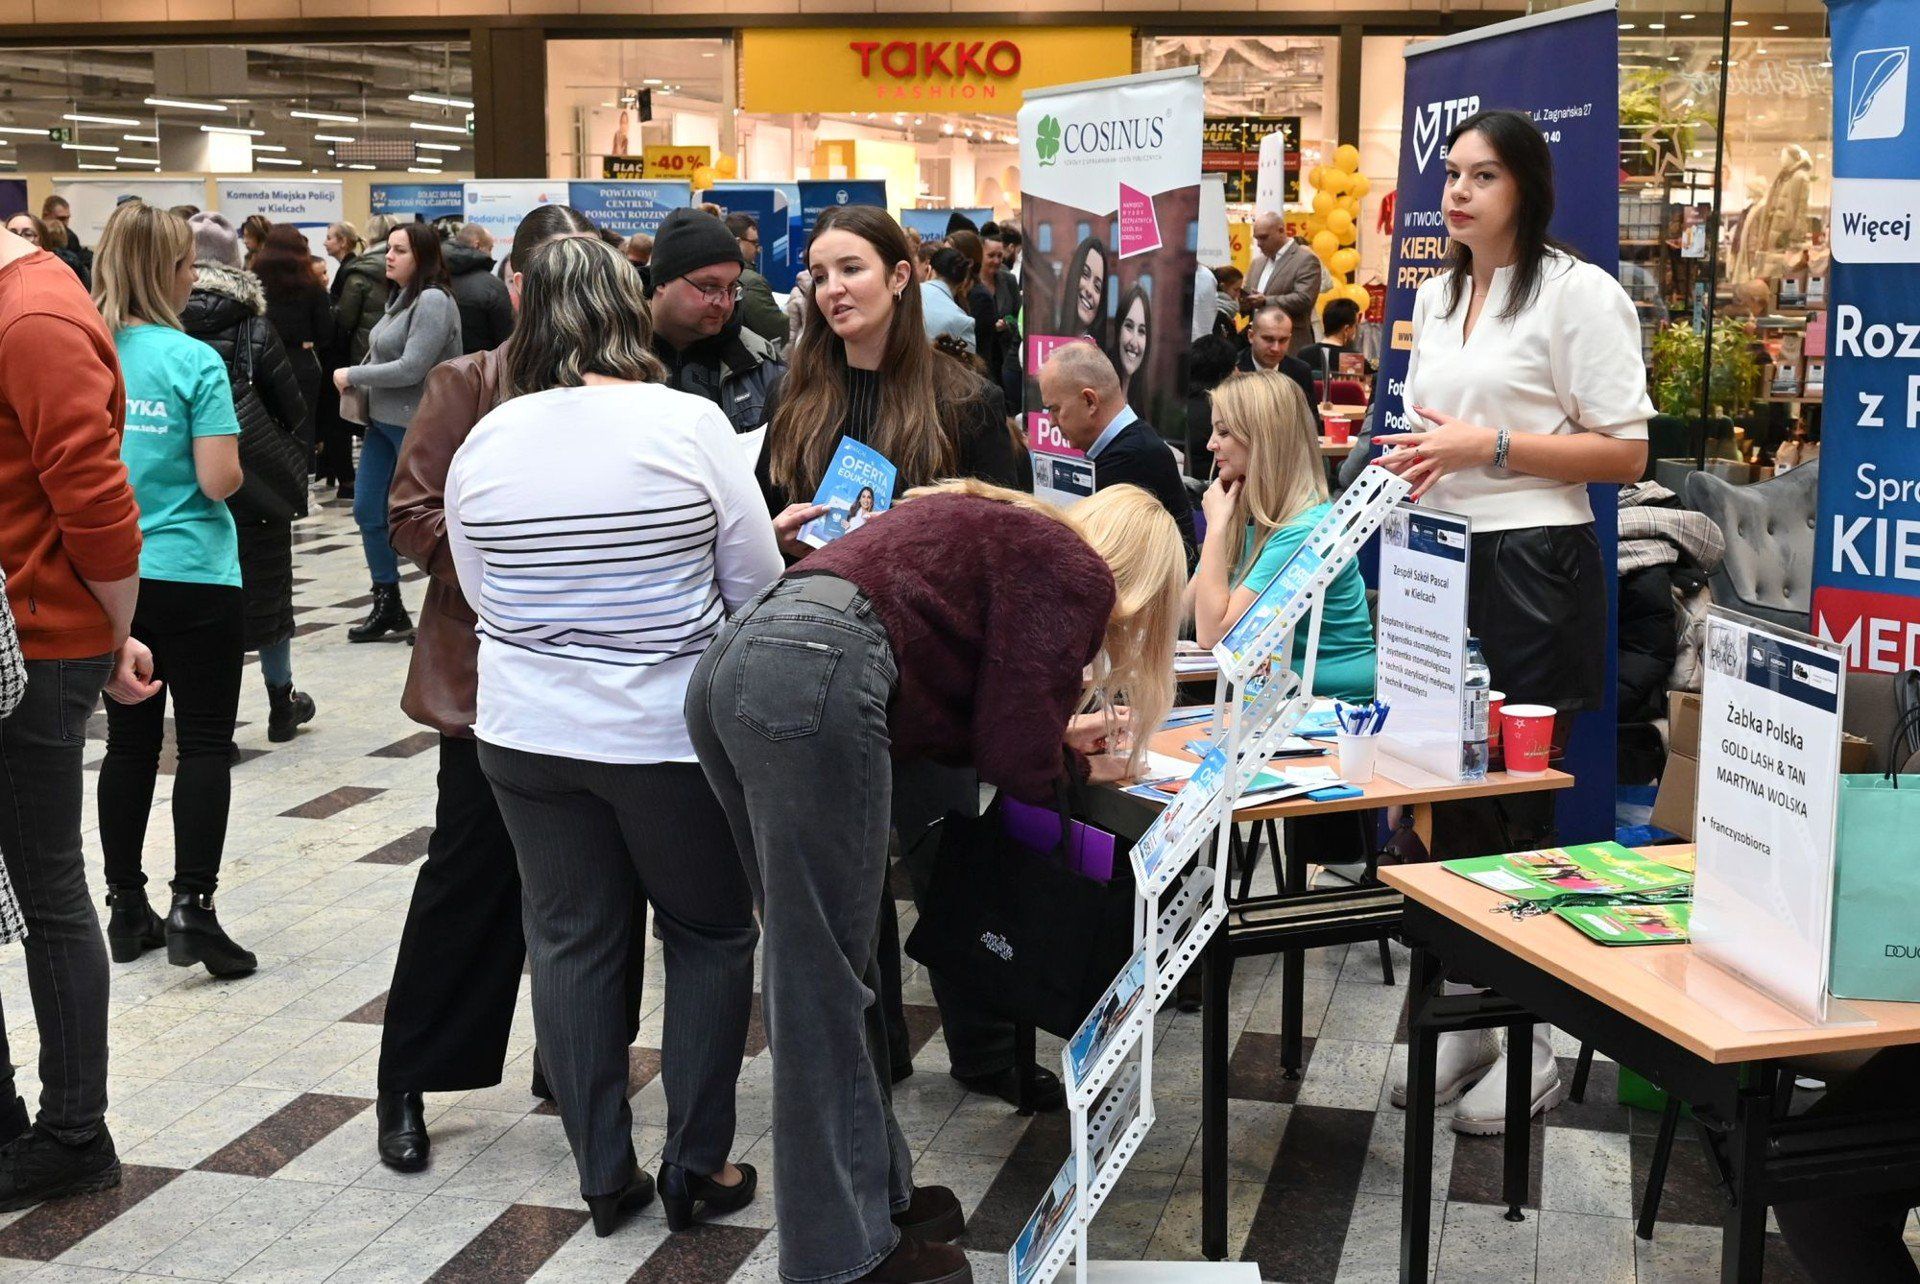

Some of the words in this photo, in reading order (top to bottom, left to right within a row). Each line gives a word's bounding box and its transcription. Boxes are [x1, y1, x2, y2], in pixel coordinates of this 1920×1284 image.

[876, 85, 996, 99] FASHION
[1583, 103, 1592, 116] 27
[1064, 116, 1163, 154] COSINUS
[1203, 122, 1235, 132] LACK
[226, 191, 270, 200] Komenda
[272, 191, 307, 202] Miejska
[308, 191, 335, 202] Policji
[605, 200, 654, 209] CENTRUM
[258, 205, 266, 213] w
[268, 203, 306, 214] Kielcach
[585, 210, 626, 220] POMOCY
[468, 214, 505, 225] Podaruj
[601, 221, 609, 230] W
[611, 221, 659, 230] KIELCACH
[1404, 212, 1411, 228] W
[1842, 212, 1911, 242] Więcej
[126, 399, 168, 418] YKA
[1856, 391, 1885, 428] z
[842, 455, 889, 490] OFERTA
[1393, 564, 1413, 580] Zespół
[1413, 569, 1430, 584] Szkół
[1430, 574, 1449, 589] Pascal
[1404, 588, 1411, 597] w
[1411, 587, 1436, 604] Kielcach
[1726, 700, 1763, 734] Żabka
[1766, 718, 1805, 752] Polska
[1721, 738, 1748, 762] GOLD
[1750, 748, 1775, 773] LASH
[1776, 759, 1786, 778] &
[1788, 763, 1807, 787] TAN
[1716, 765, 1765, 800] MARTYNA
[1767, 785, 1809, 820] WOLSKA
[1709, 815, 1772, 856] franczyzobiorca
[1885, 944, 1920, 959] DOU
